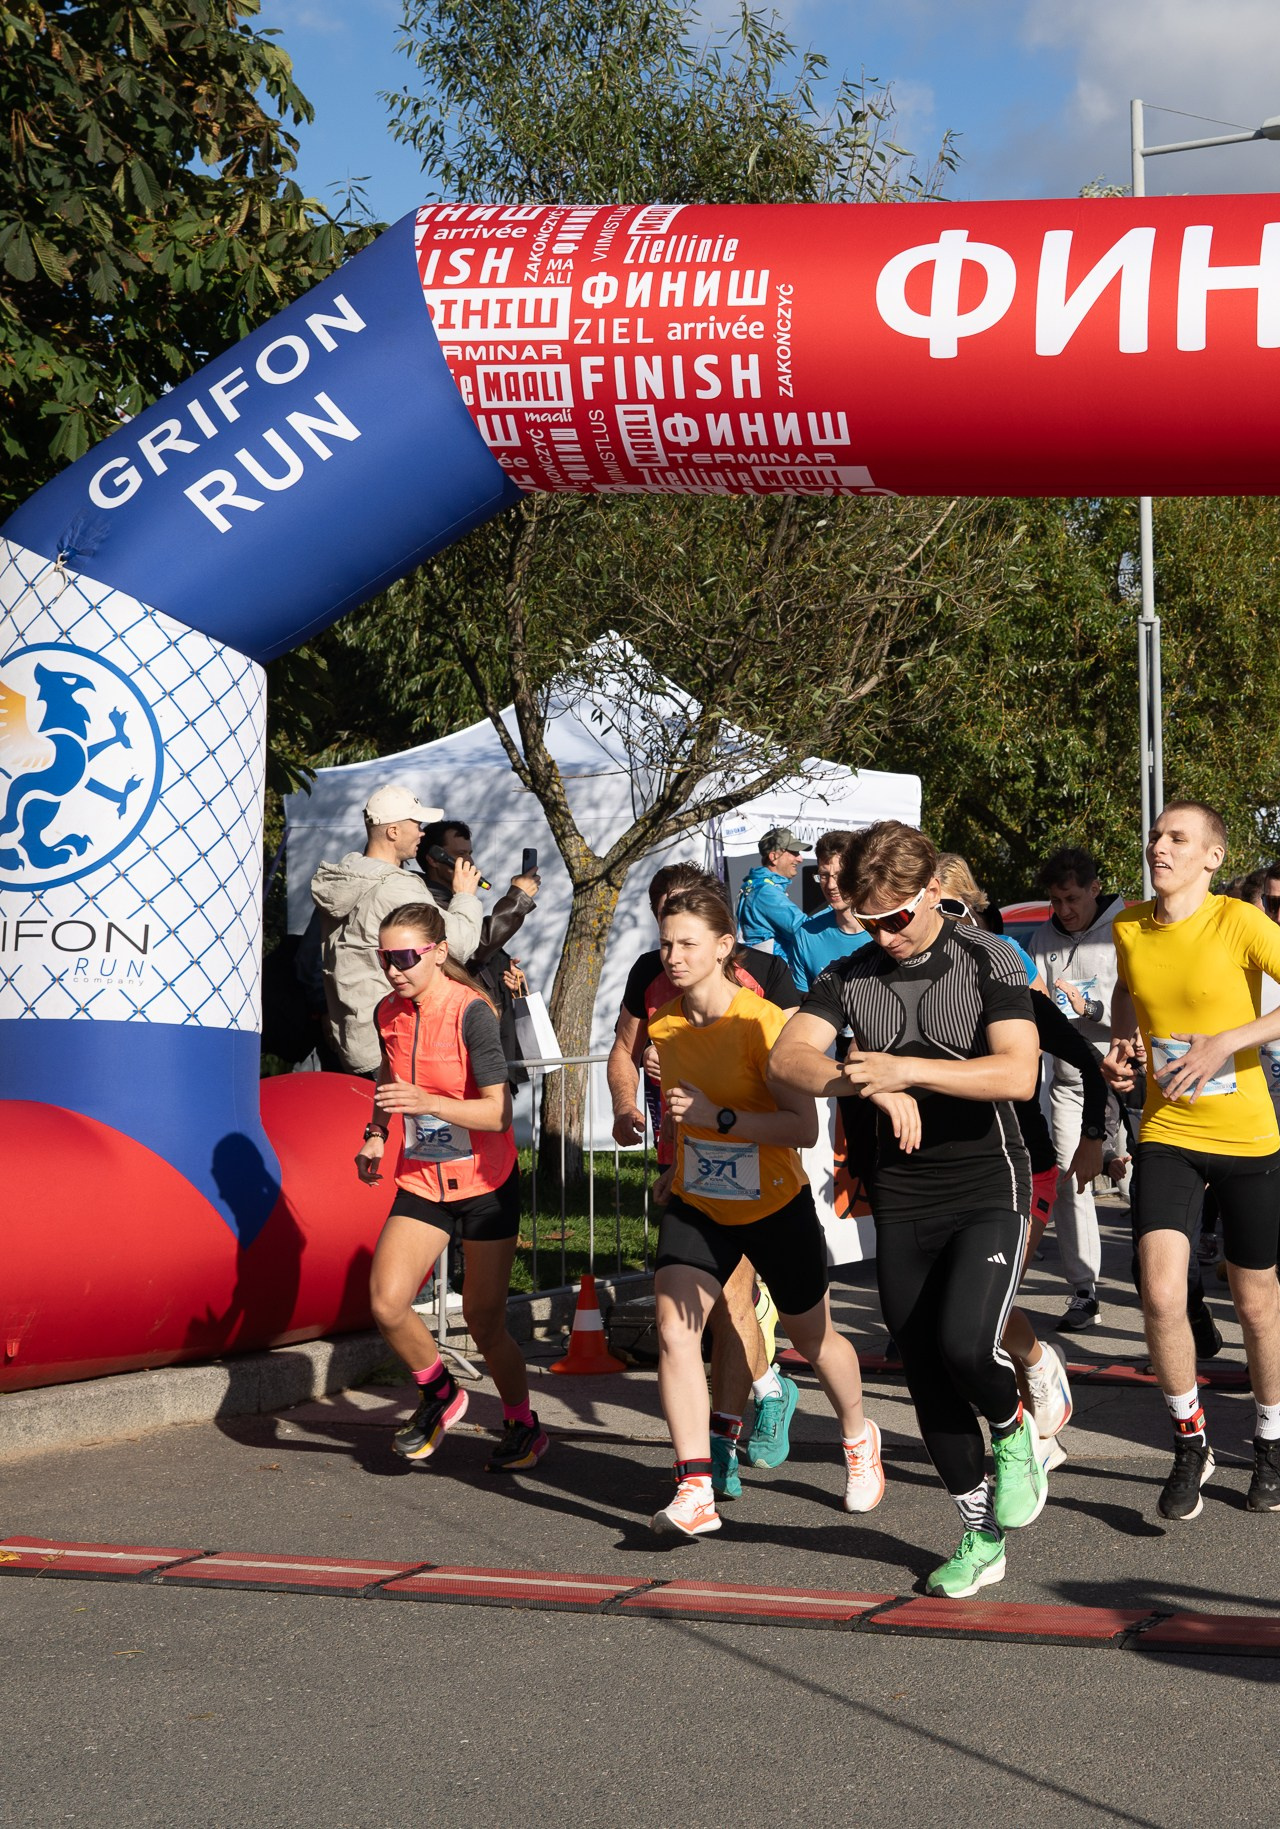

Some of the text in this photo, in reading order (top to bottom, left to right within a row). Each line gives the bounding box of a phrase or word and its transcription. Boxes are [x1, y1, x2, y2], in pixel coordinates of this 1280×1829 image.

[433, 224, 527, 240] arrivée
[623, 234, 739, 264] Ziellinie
[417, 247, 514, 286] ISH
[546, 258, 574, 270] MA
[542, 271, 572, 284] ALI
[581, 269, 770, 309] ФИНИШ
[573, 314, 764, 345] ZIEL arrivée
[772, 282, 795, 398] ZAKOŃCZYĆ
[442, 345, 562, 361] RMINAR
[482, 371, 564, 402] MAALI
[580, 353, 762, 400] FINISH
[88, 293, 367, 510] GRIFON
[524, 408, 573, 423] maali
[622, 409, 659, 465] MAALI
[662, 411, 851, 446] ФИНИШ
[182, 391, 362, 534] RUN
[668, 452, 836, 464] TERMINAR
[638, 467, 846, 487] Ziellinie MAALI
[74, 957, 145, 978] RUN
[73, 976, 145, 987] company
[1056, 991, 1091, 1005] 34
[698, 1158, 736, 1178] 371
